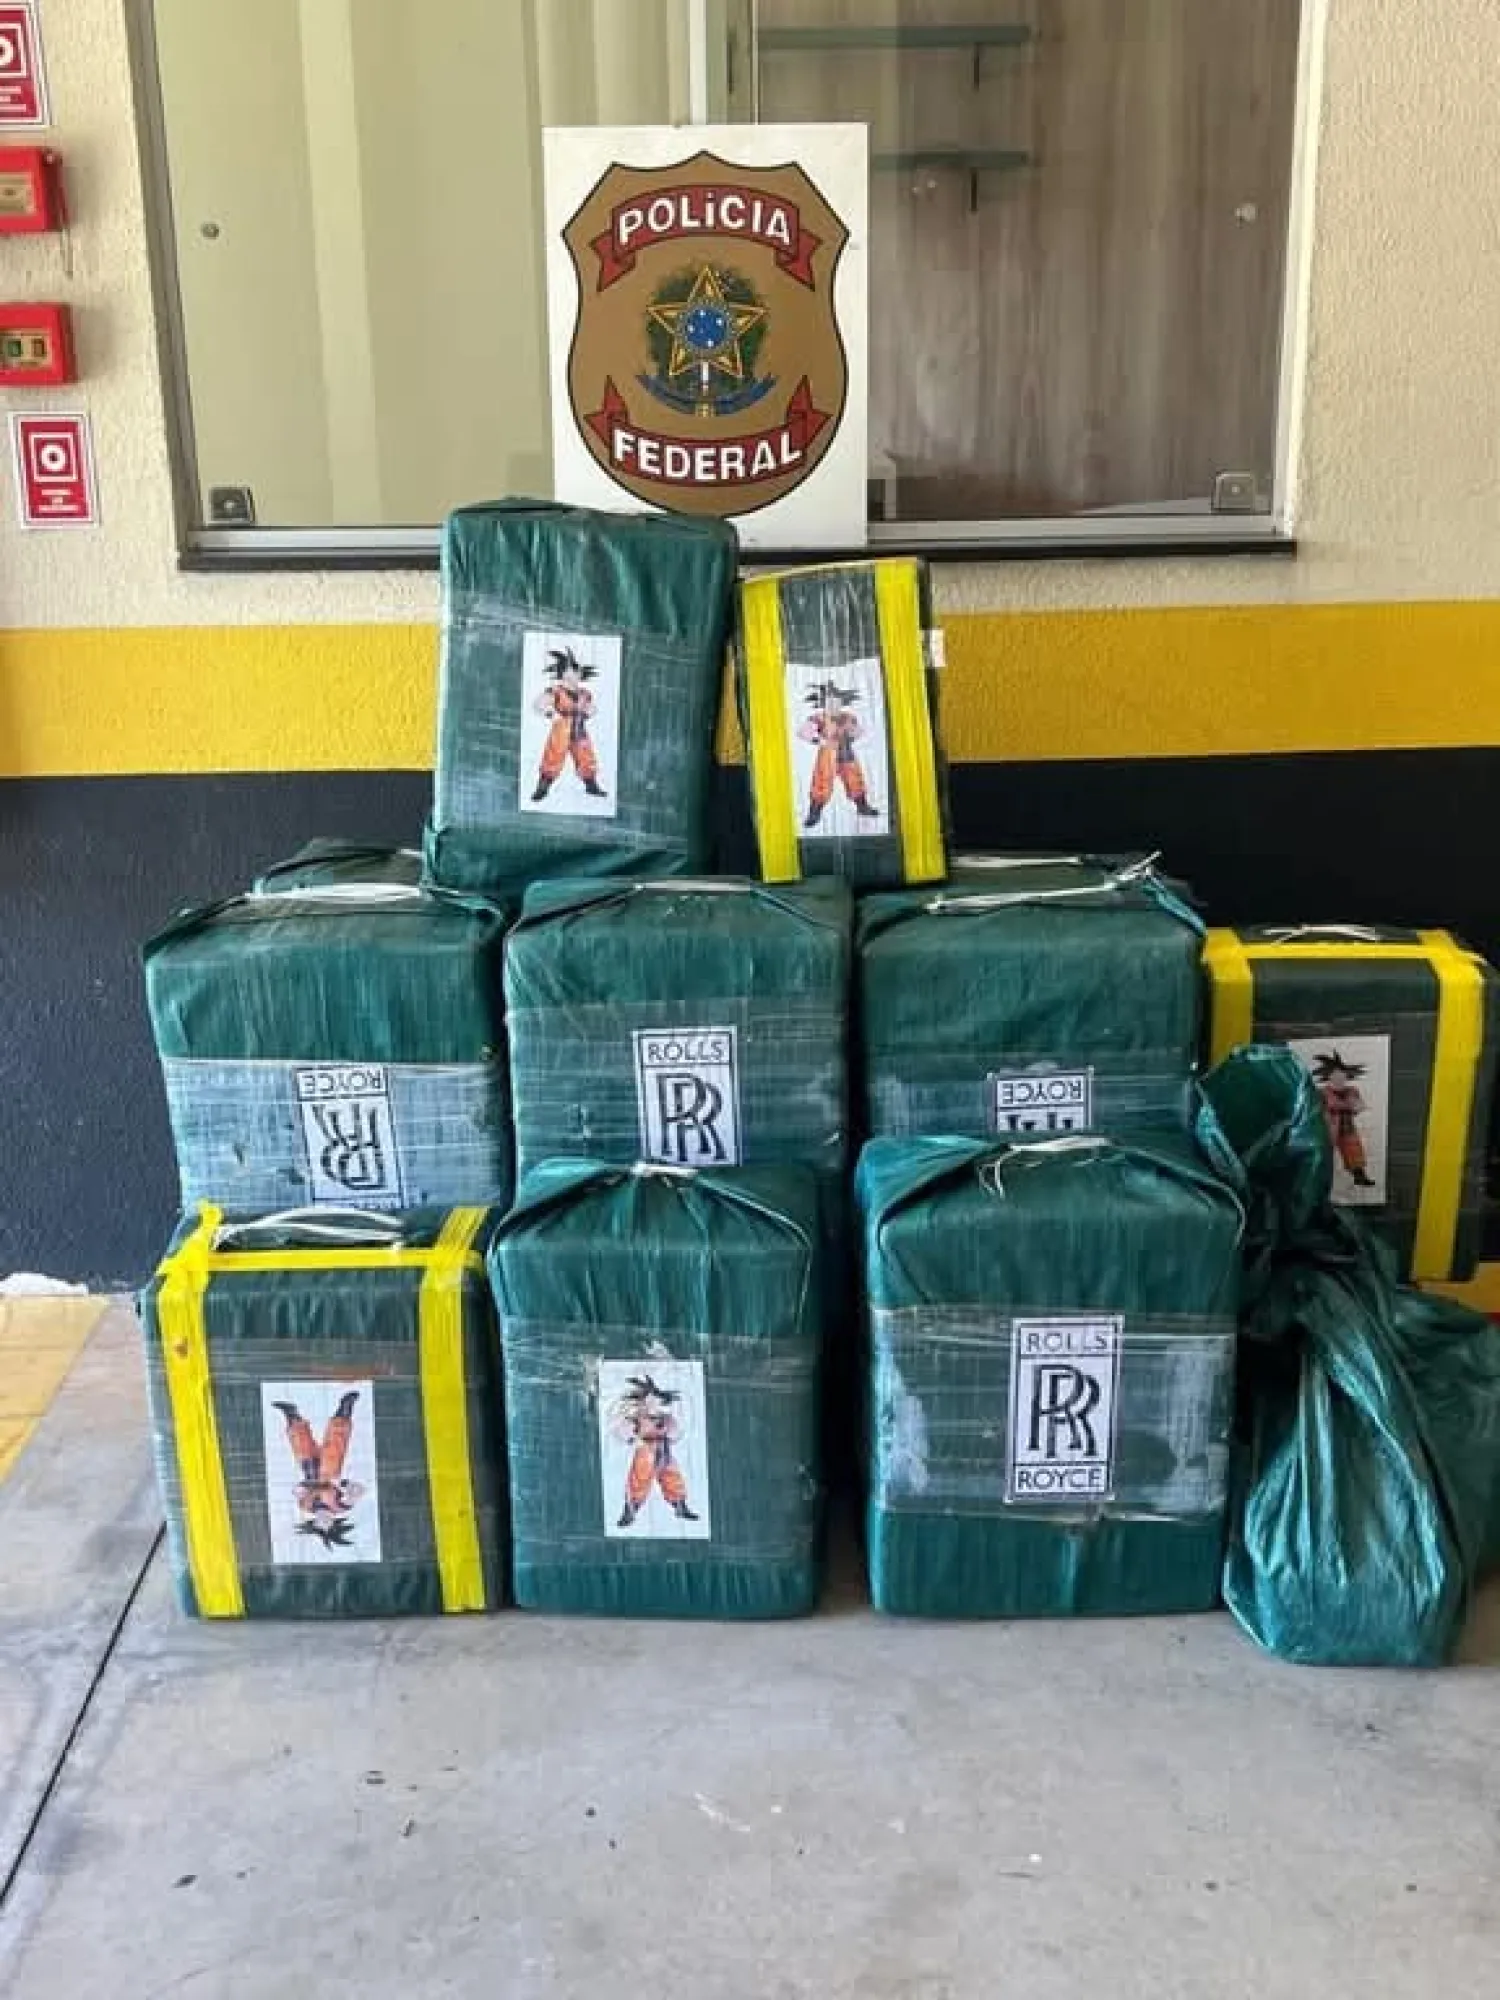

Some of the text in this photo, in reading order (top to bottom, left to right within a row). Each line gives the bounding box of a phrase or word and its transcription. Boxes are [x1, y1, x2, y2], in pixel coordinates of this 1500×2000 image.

[613, 429, 802, 481] FEDERAL
[648, 1040, 724, 1061] ROLLS
[303, 1070, 382, 1095] ROYCE
[1002, 1080, 1081, 1105] ROYCE
[1018, 1467, 1103, 1490] ROYCE
